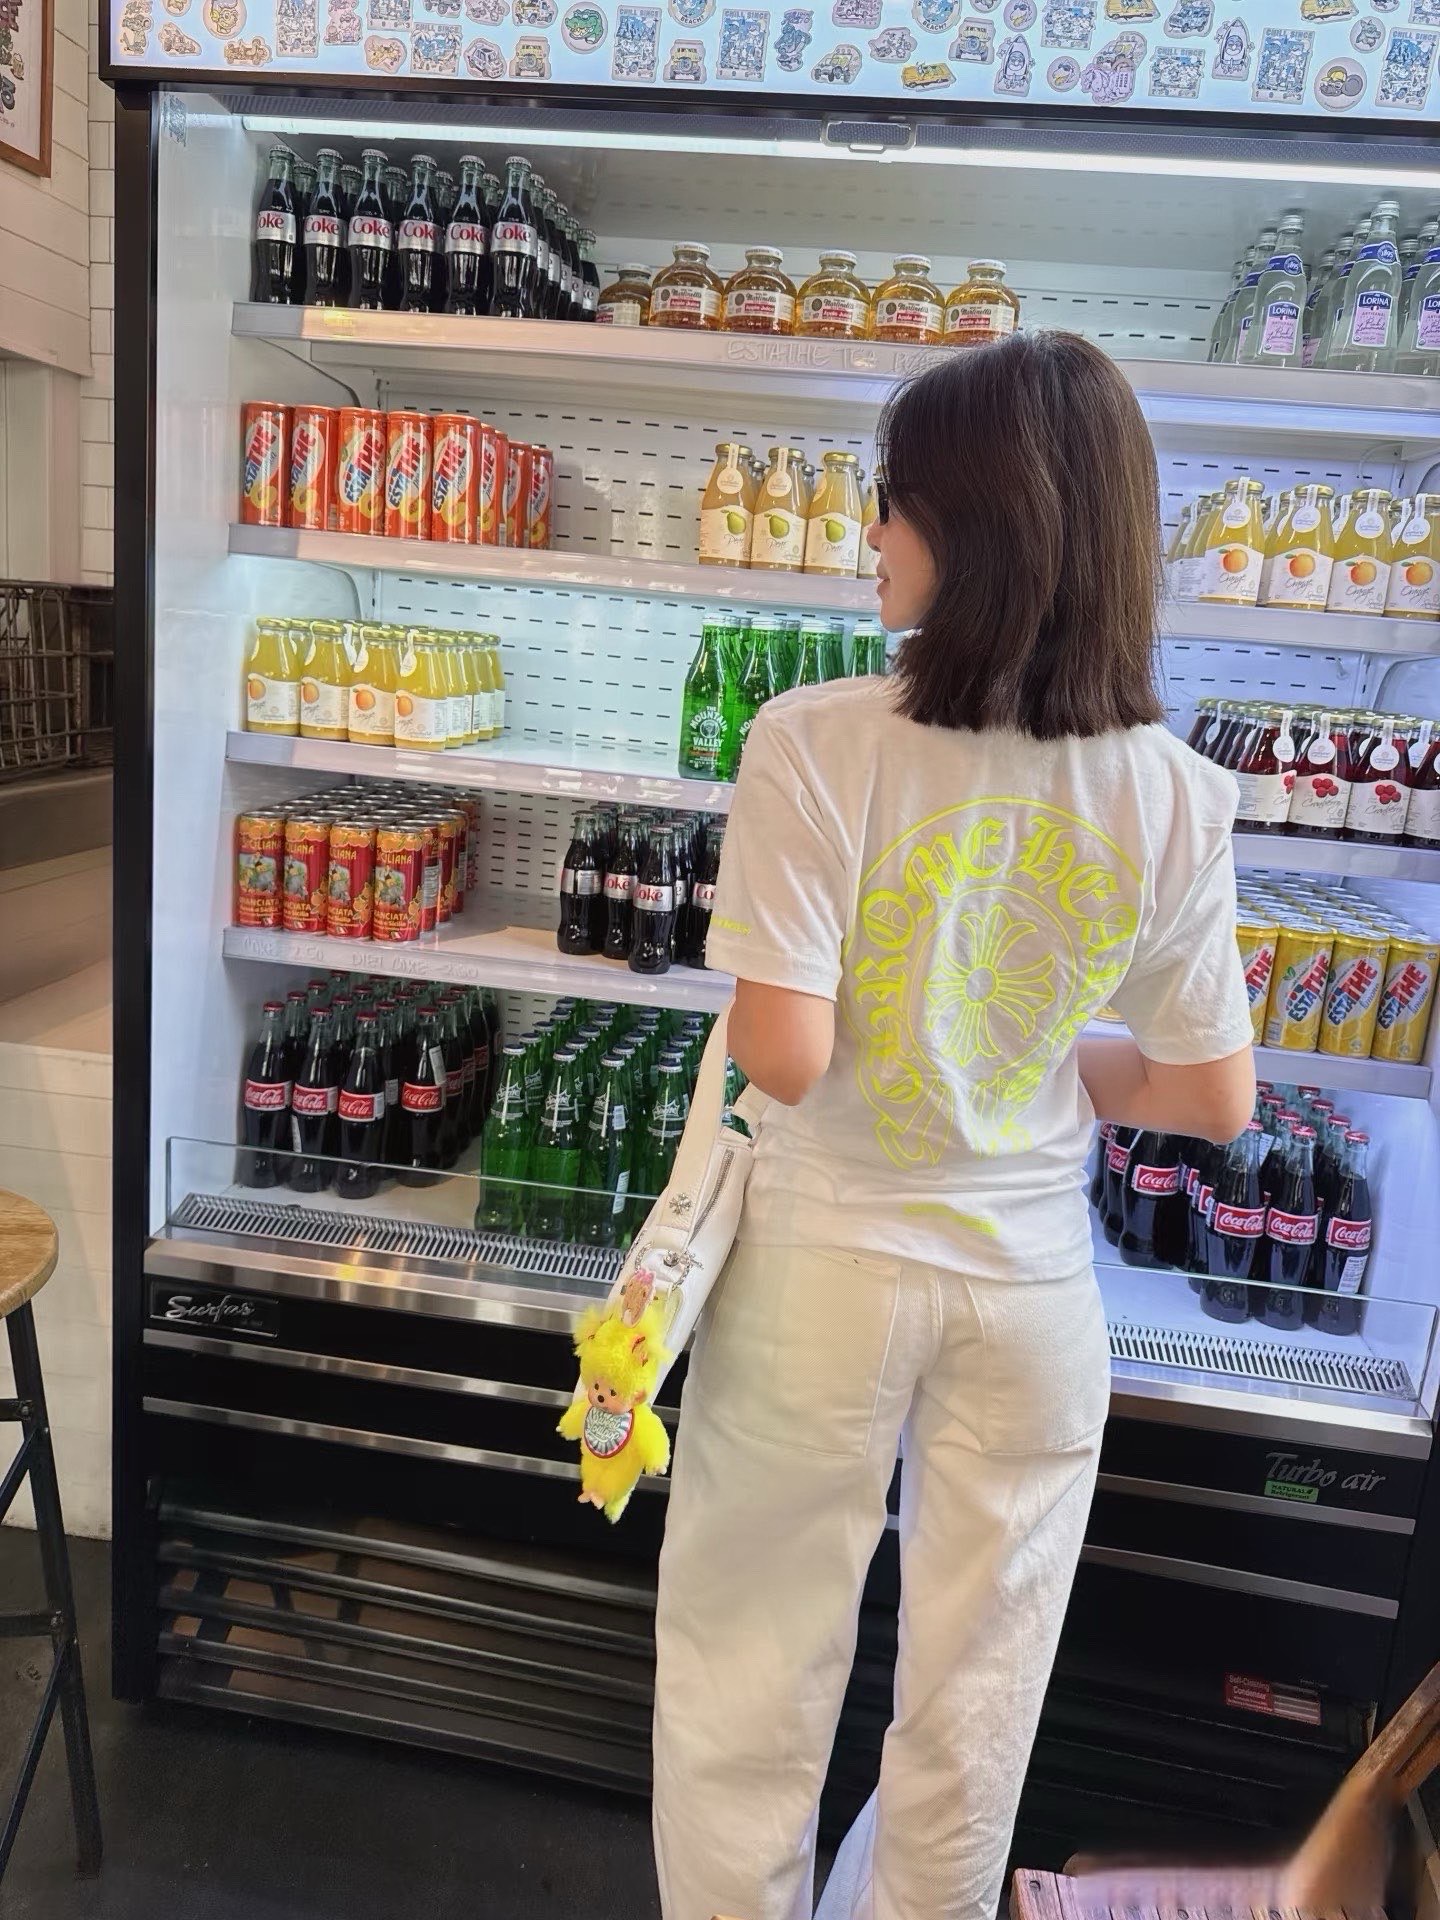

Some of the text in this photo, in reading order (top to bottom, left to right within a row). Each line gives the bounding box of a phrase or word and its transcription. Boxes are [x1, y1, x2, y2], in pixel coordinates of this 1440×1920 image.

[305, 217, 340, 235] Coke
[352, 217, 390, 238] Coke
[495, 224, 531, 242] Coke
[1362, 296, 1389, 306] LORINA
[1272, 306, 1297, 317] LORINA
[690, 711, 728, 732] MOUNTAIN
[693, 737, 724, 748] VALLEY
[1271, 1217, 1314, 1238] Coca-Cola
[1265, 1452, 1386, 1492] Turbo air
